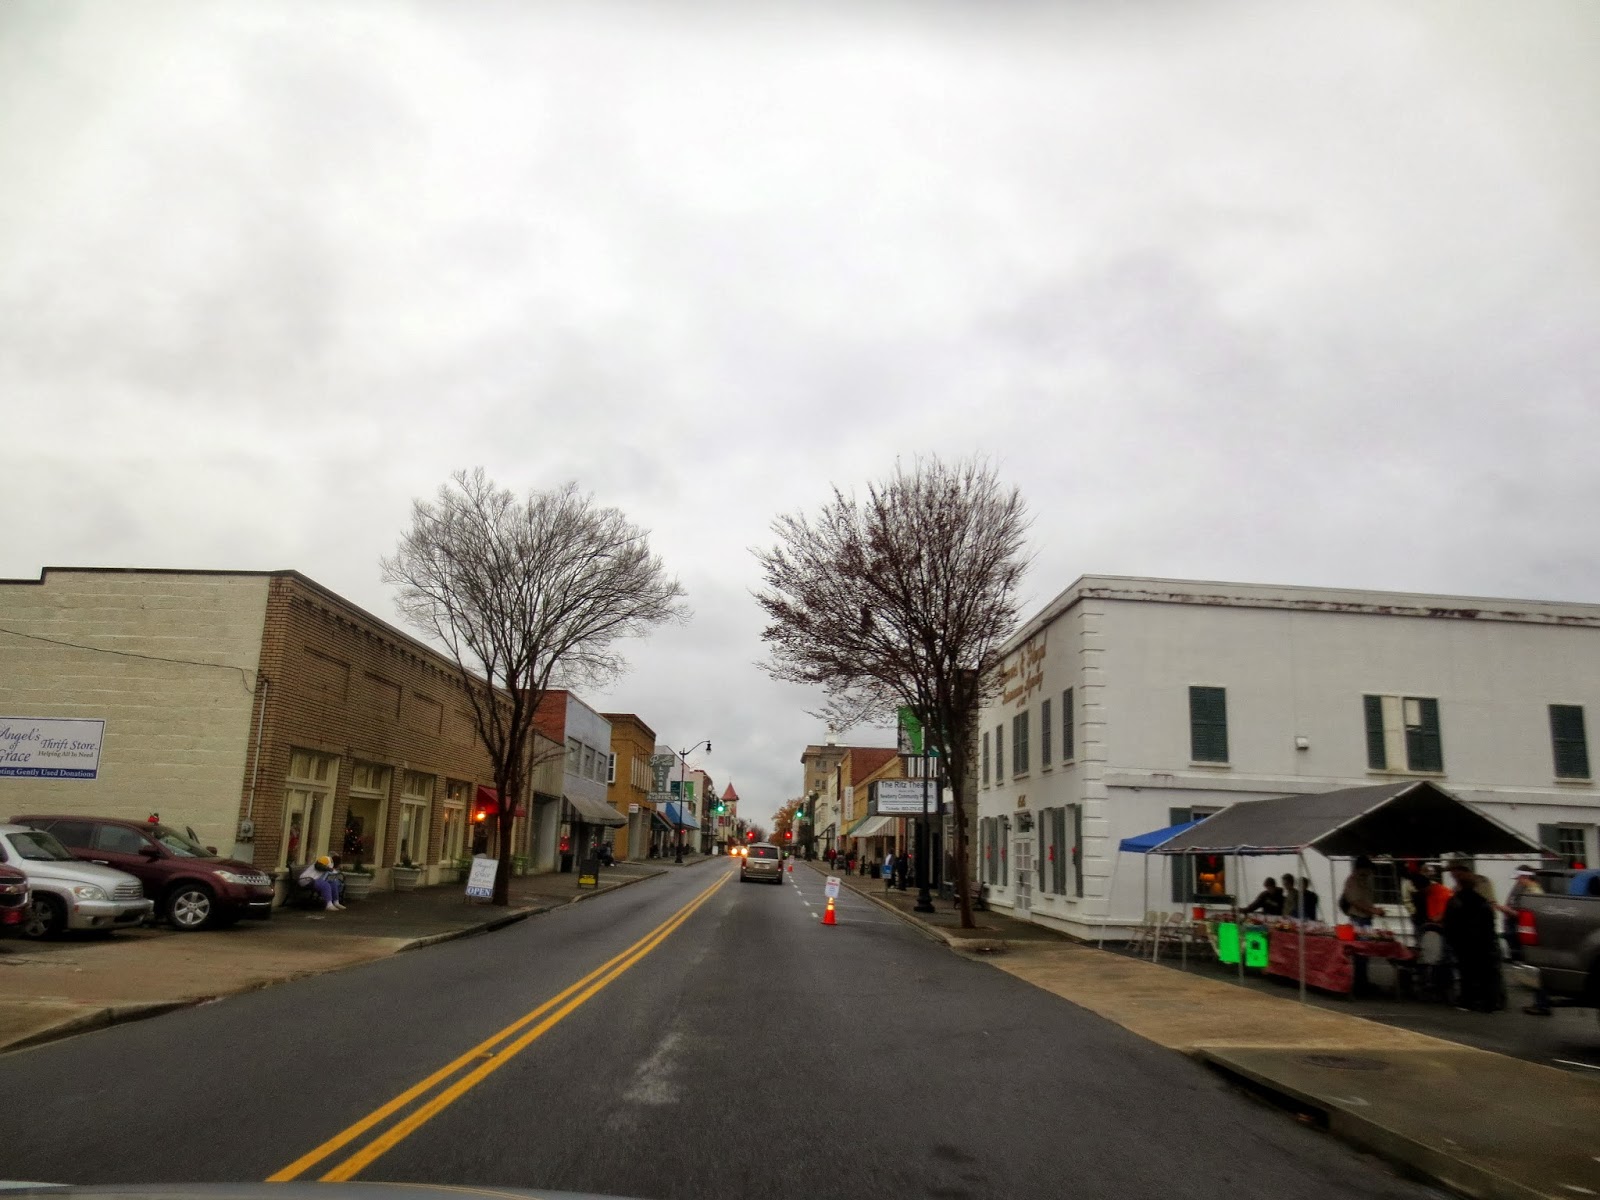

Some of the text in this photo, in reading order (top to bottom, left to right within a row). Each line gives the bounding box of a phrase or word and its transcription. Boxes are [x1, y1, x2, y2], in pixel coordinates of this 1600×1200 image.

[9, 741, 21, 752] of
[40, 738, 96, 752] Thrift Store
[38, 750, 61, 758] Helping
[16, 768, 39, 777] Gently
[41, 769, 58, 777] Used
[60, 769, 95, 778] Donations
[881, 781, 893, 789] The
[894, 781, 907, 789] Ritz
[467, 886, 491, 897] OPEN
